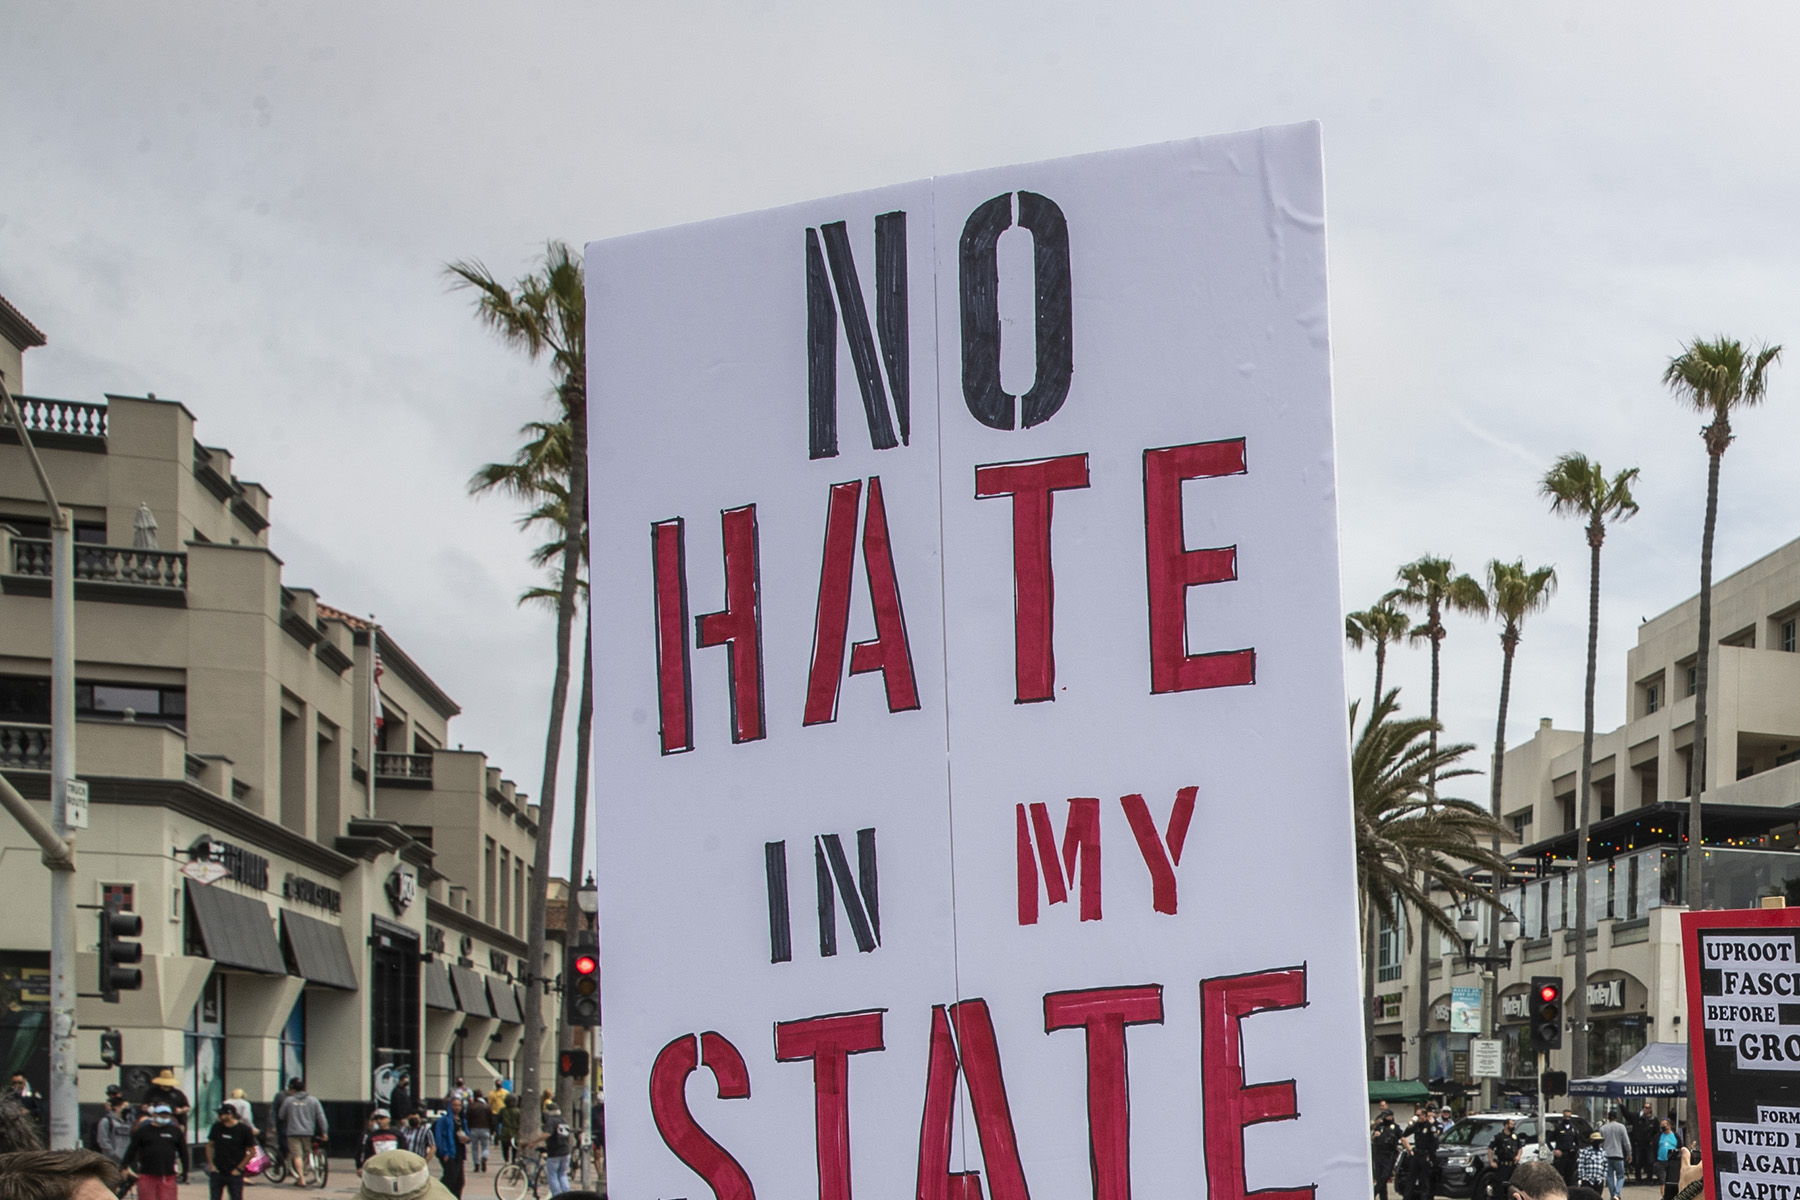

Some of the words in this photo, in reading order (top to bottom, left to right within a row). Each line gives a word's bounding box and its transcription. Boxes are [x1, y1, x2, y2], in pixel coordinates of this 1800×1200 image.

[805, 189, 1074, 460] NO
[650, 437, 1257, 756] HATE
[763, 827, 882, 964] IN
[1015, 785, 1200, 927] MY
[1706, 942, 1792, 962] UPROOT
[1707, 1004, 1776, 1023] BEFORE
[1718, 1028, 1734, 1043] IT
[1641, 1065, 1686, 1075] HUNTI
[1760, 1110, 1800, 1124] FORM
[1721, 1128, 1790, 1148] UNITED
